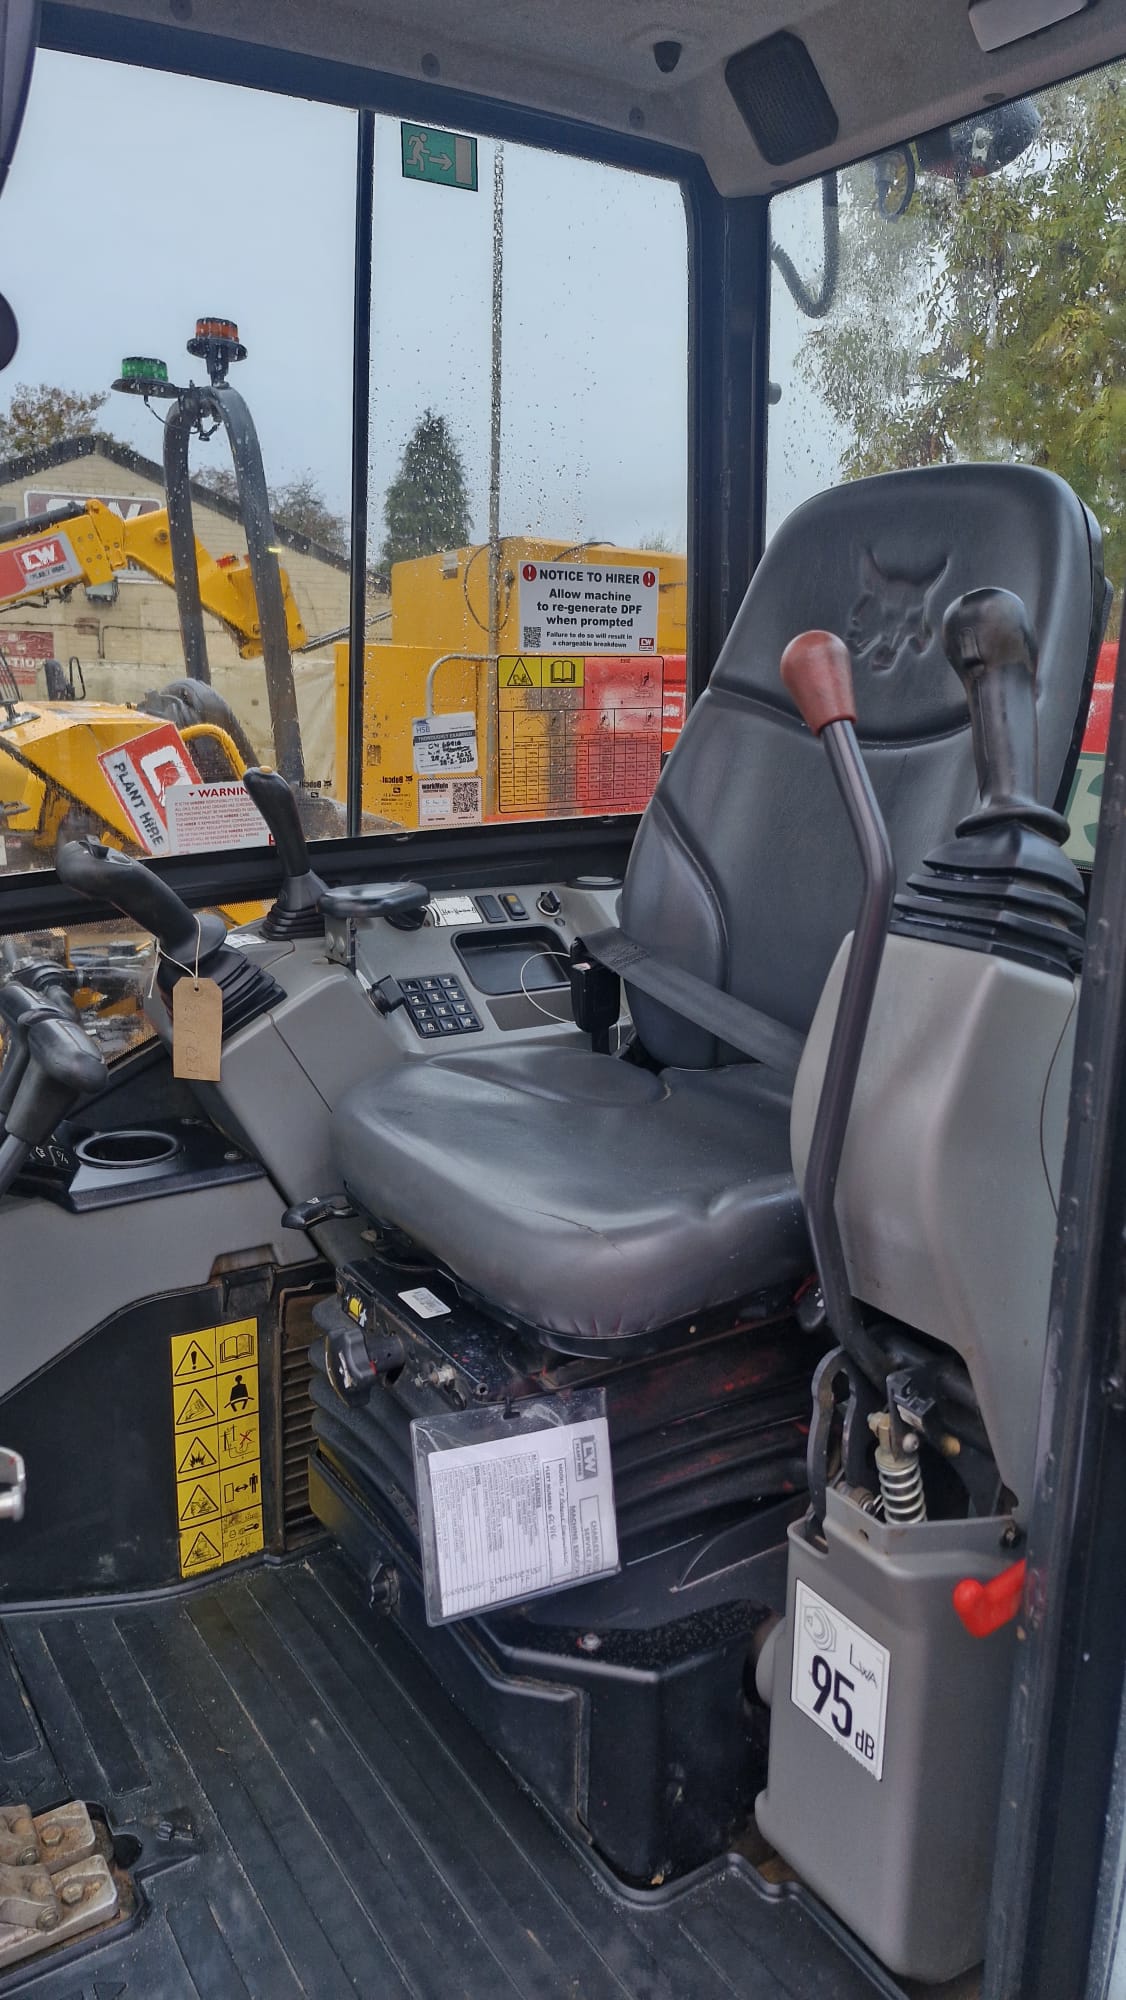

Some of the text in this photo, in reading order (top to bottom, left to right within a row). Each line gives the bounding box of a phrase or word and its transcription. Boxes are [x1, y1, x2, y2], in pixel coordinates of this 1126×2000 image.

[539, 569, 640, 585] NOTICE TO HIRER
[549, 588, 632, 602] Allow machine
[536, 602, 642, 615] to re-generate DPF
[546, 615, 634, 629] when prompted
[557, 640, 592, 648] chargeable
[198, 787, 248, 798] WARNIN
[114, 761, 165, 847] PLANT HIRE
[584, 1527, 592, 1557] SERVICE
[590, 1520, 599, 1553] CHARLES
[811, 1654, 854, 1738] 95
[855, 1729, 875, 1761] dB
